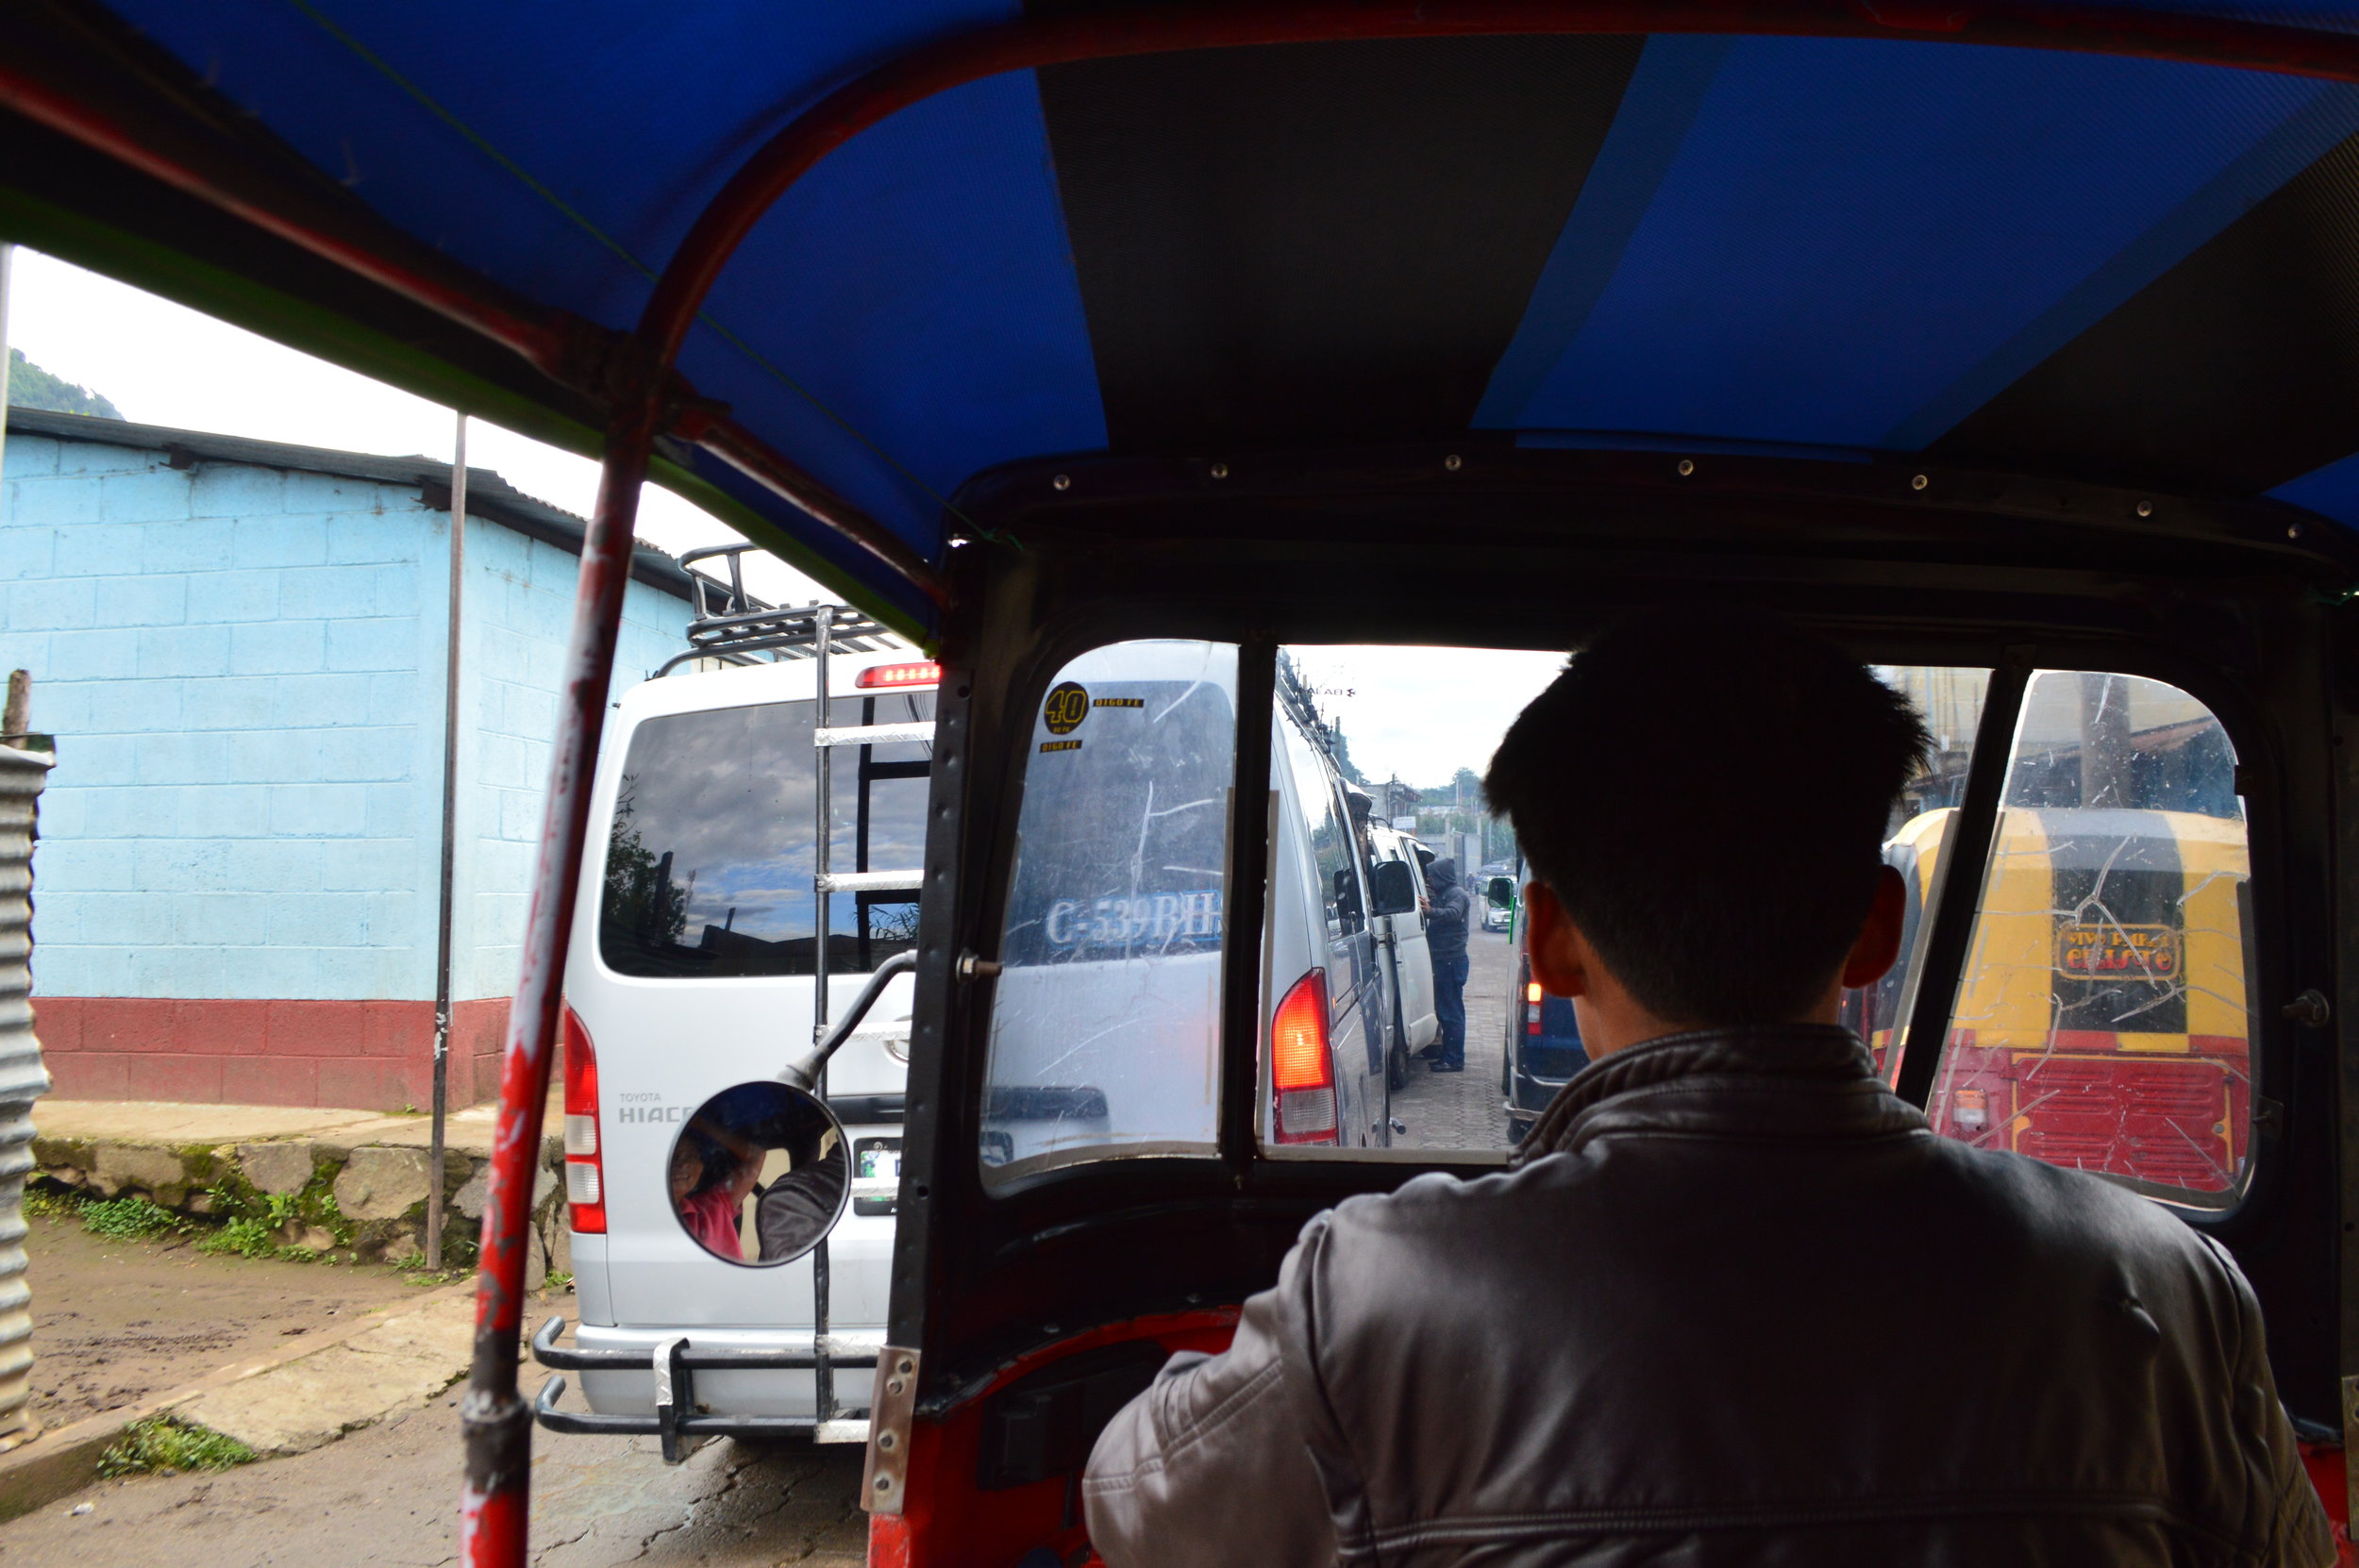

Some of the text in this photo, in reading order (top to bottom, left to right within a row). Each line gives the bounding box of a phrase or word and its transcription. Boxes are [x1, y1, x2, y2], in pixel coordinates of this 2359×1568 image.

[1046, 690, 1086, 724] 40
[1047, 892, 1223, 945] C-539BH
[619, 1093, 661, 1102] TOYOTA
